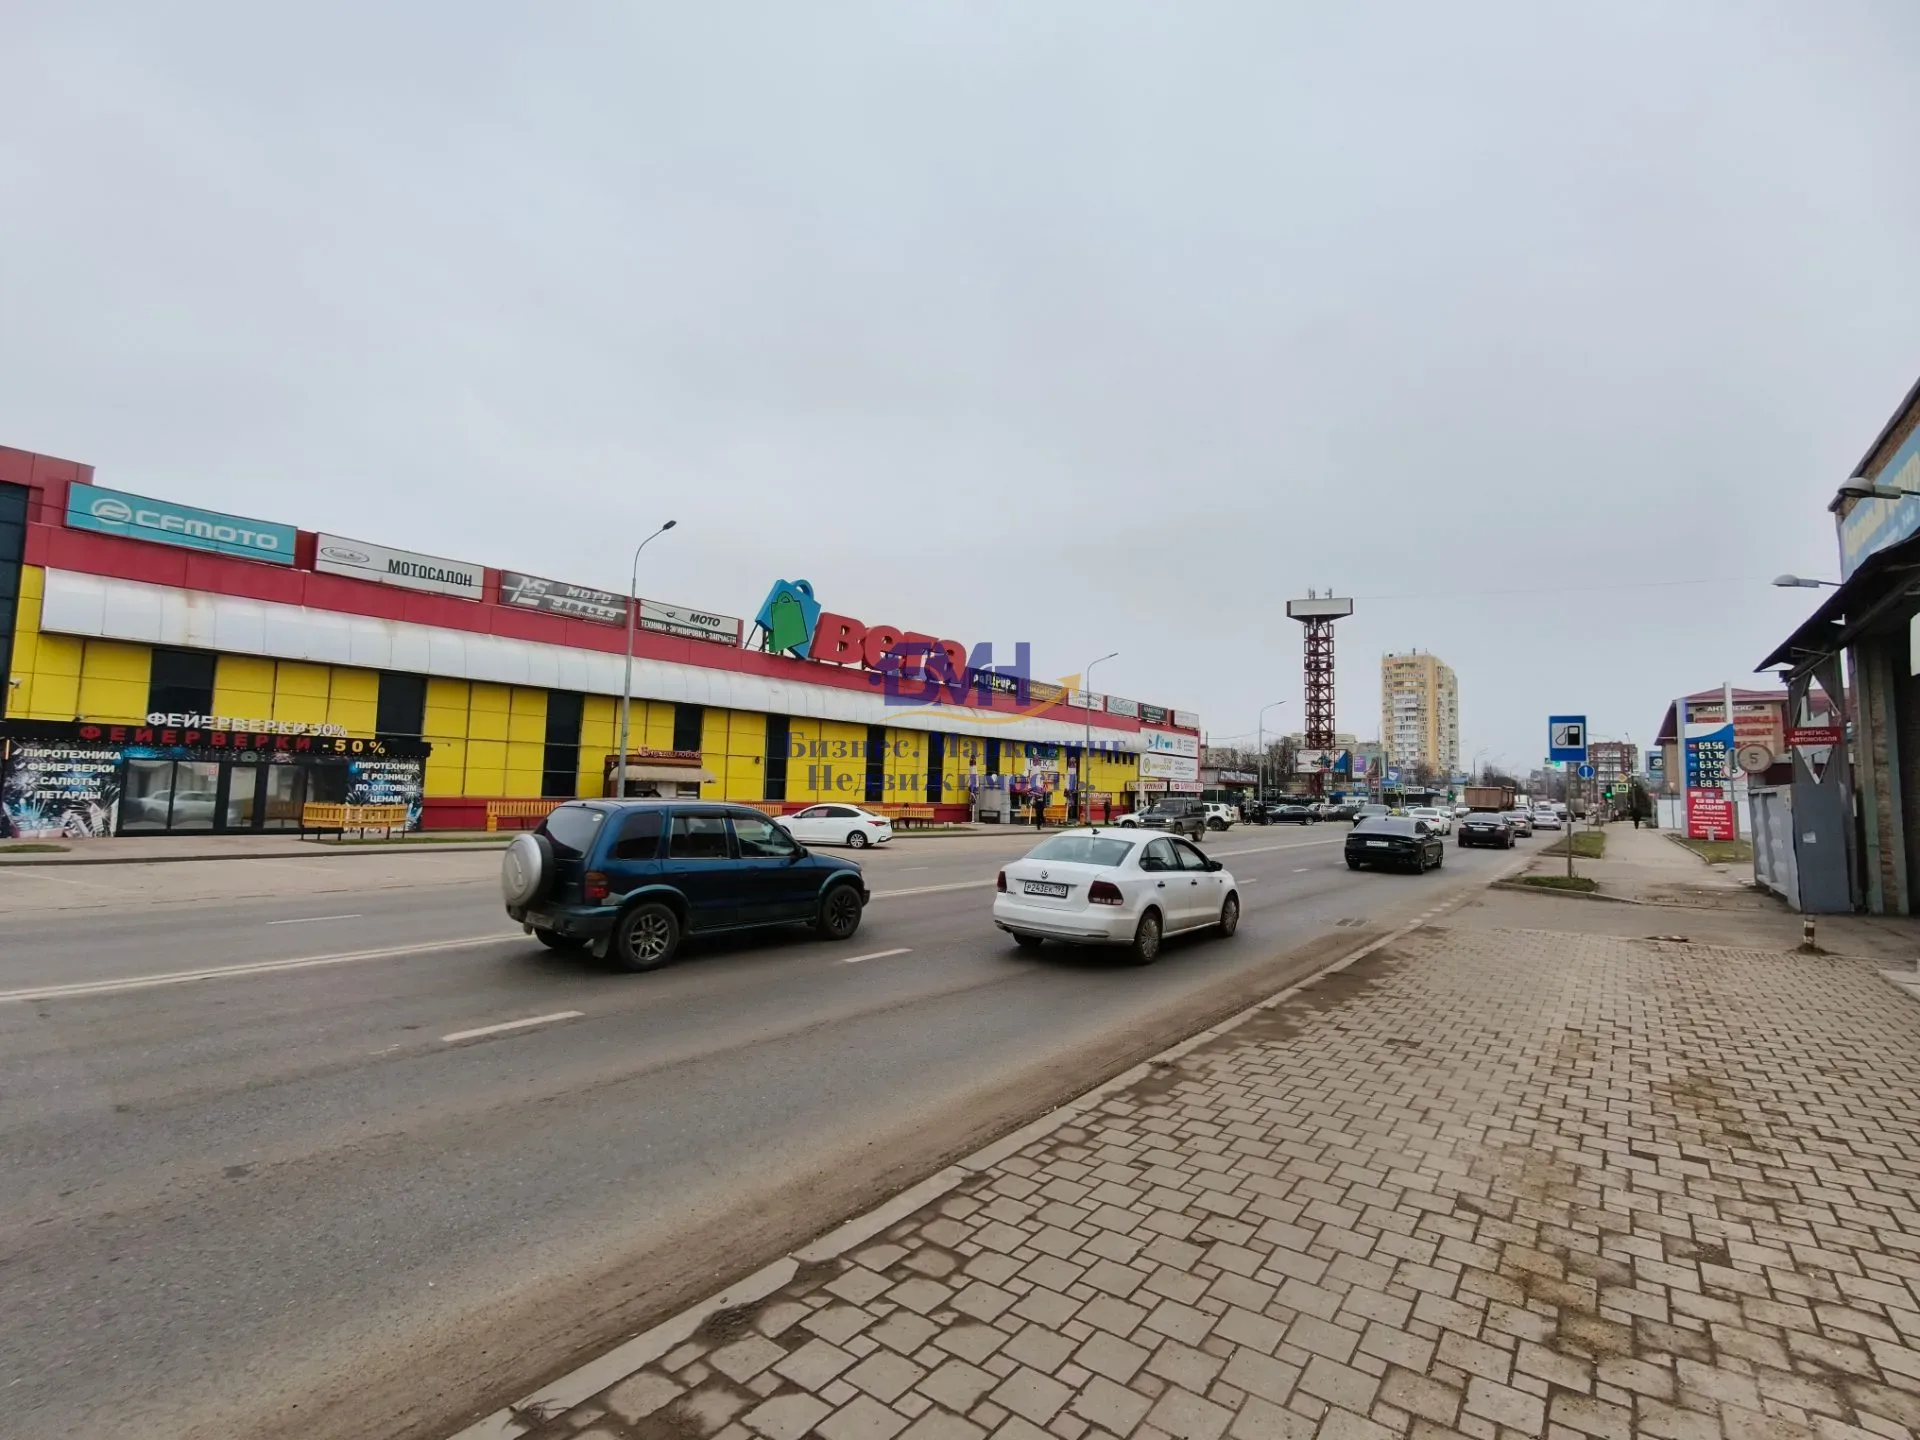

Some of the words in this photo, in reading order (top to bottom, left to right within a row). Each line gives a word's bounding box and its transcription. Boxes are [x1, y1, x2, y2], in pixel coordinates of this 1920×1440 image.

[136, 509, 278, 550] CFMOTO
[388, 558, 473, 587] МОТОСАЛОН
[1698, 742, 1725, 750] 69.56
[23, 748, 121, 760] ПИРОТЕХНИКА
[1749, 752, 1759, 764] 5
[355, 761, 420, 771] ПИРОТЕХНИКА
[40, 776, 101, 786] САЛЮТЫ
[371, 773, 413, 781] РОЗНИЦУ
[355, 783, 369, 791] ПО
[371, 784, 417, 792] ОПТОВЫМ
[36, 790, 102, 801] ПЕТАРДЫ
[369, 795, 402, 803] ЦЕНАМ
